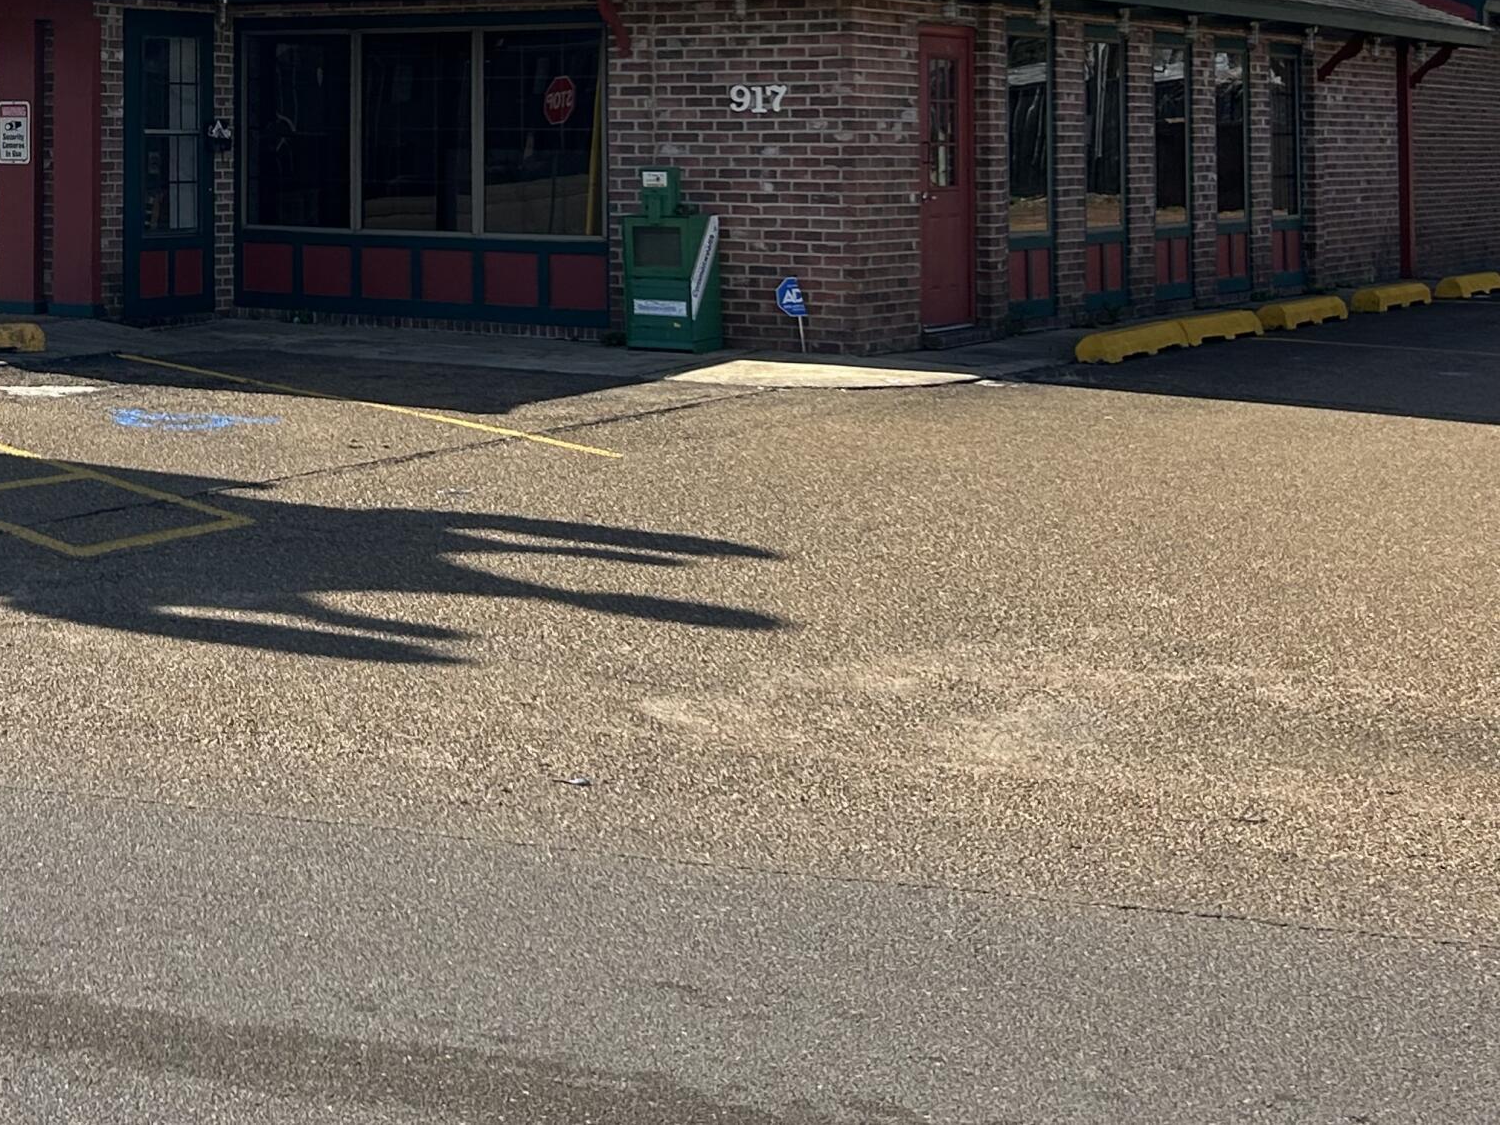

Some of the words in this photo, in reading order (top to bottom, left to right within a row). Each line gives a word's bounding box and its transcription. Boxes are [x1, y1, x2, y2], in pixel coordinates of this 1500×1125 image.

[729, 83, 788, 114] 917
[2, 133, 25, 142] Security
[782, 288, 804, 304] AD
